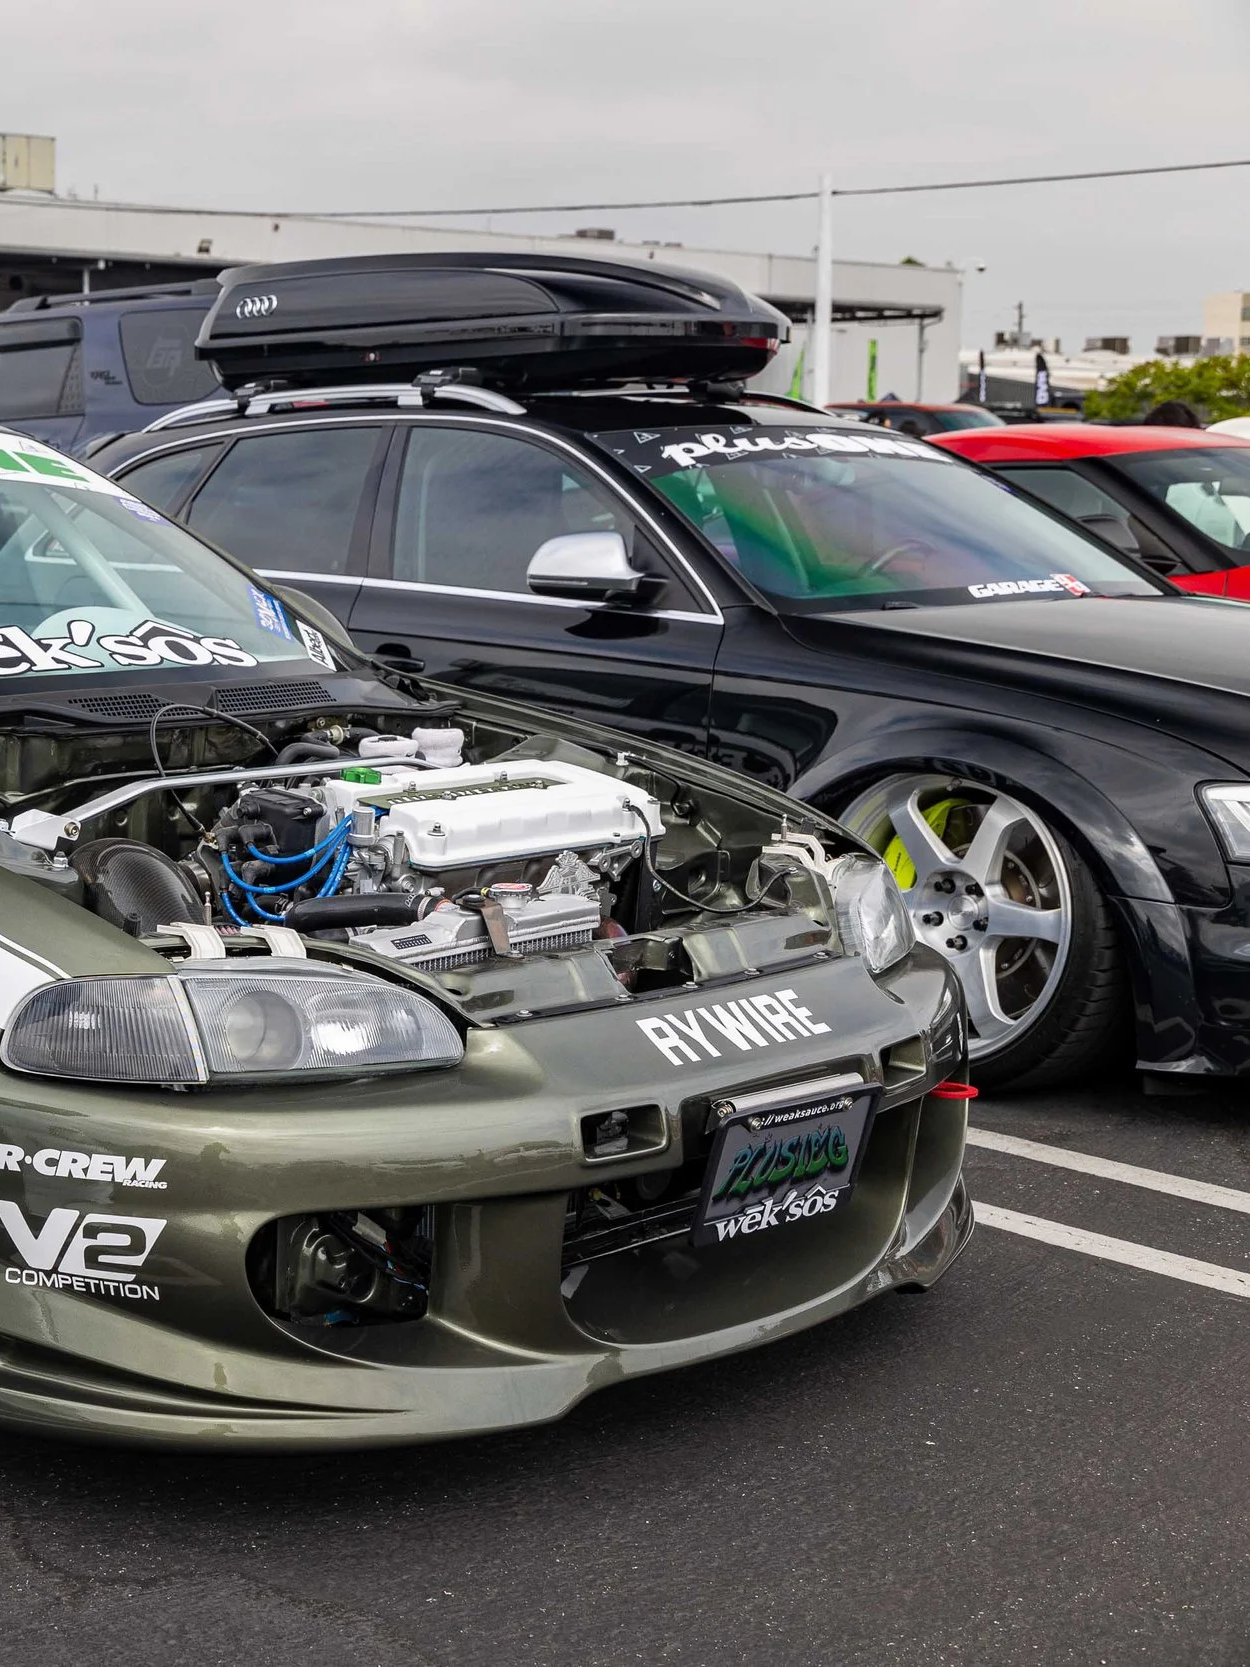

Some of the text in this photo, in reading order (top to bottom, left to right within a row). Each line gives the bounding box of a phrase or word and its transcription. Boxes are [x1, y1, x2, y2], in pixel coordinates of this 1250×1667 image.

[967, 579, 1065, 599] GARAGE
[635, 989, 833, 1066] RYWIRE
[122, 1179, 168, 1190] RACING
[5, 1267, 160, 1301] COMPETITION
